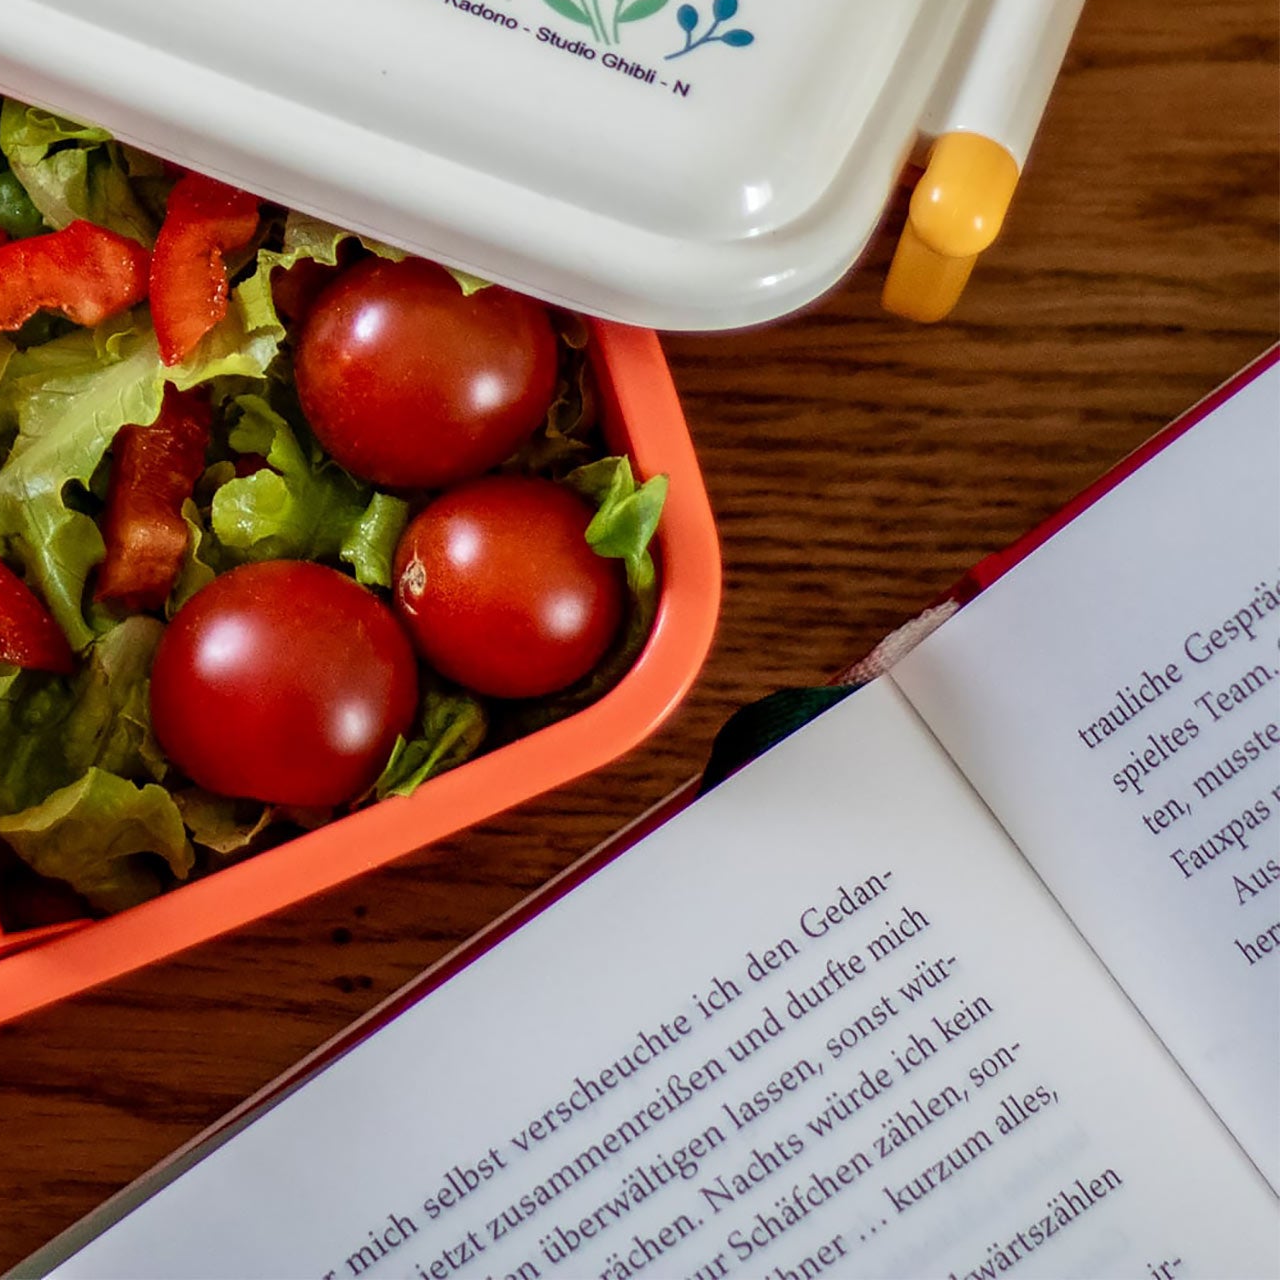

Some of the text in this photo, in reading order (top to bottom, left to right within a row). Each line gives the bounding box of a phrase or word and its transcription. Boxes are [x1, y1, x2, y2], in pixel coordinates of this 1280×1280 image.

[536, 27, 596, 60] Studio
[601, 52, 657, 84] Ghibli
[672, 79, 691, 98] N
[1078, 581, 1280, 749] trauliche Gesprä
[1113, 666, 1279, 795] spieltes Team.
[1142, 799, 1191, 835] ten,
[1169, 800, 1271, 879] Fauxpas
[345, 871, 892, 1277] mich selbst verscheuchte ich den Gedan-
[486, 1059, 727, 1242] zusammenreißen
[726, 1007, 786, 1062] und
[786, 955, 866, 1020] durfte
[867, 906, 930, 962] mich
[539, 957, 956, 1265] überwältigen lassen, sonst wür-
[699, 1134, 804, 1214] Nachts
[806, 1069, 894, 1137] würde
[891, 1034, 938, 1075] ich
[931, 997, 994, 1044] kein
[727, 1153, 874, 1262] Schäfchen
[873, 1086, 969, 1159] zählen,
[969, 1043, 1020, 1088] son-
[882, 1131, 994, 1214] kurzum
[995, 1085, 1058, 1135] alles,
[949, 1169, 1123, 1280] wärtszählen
